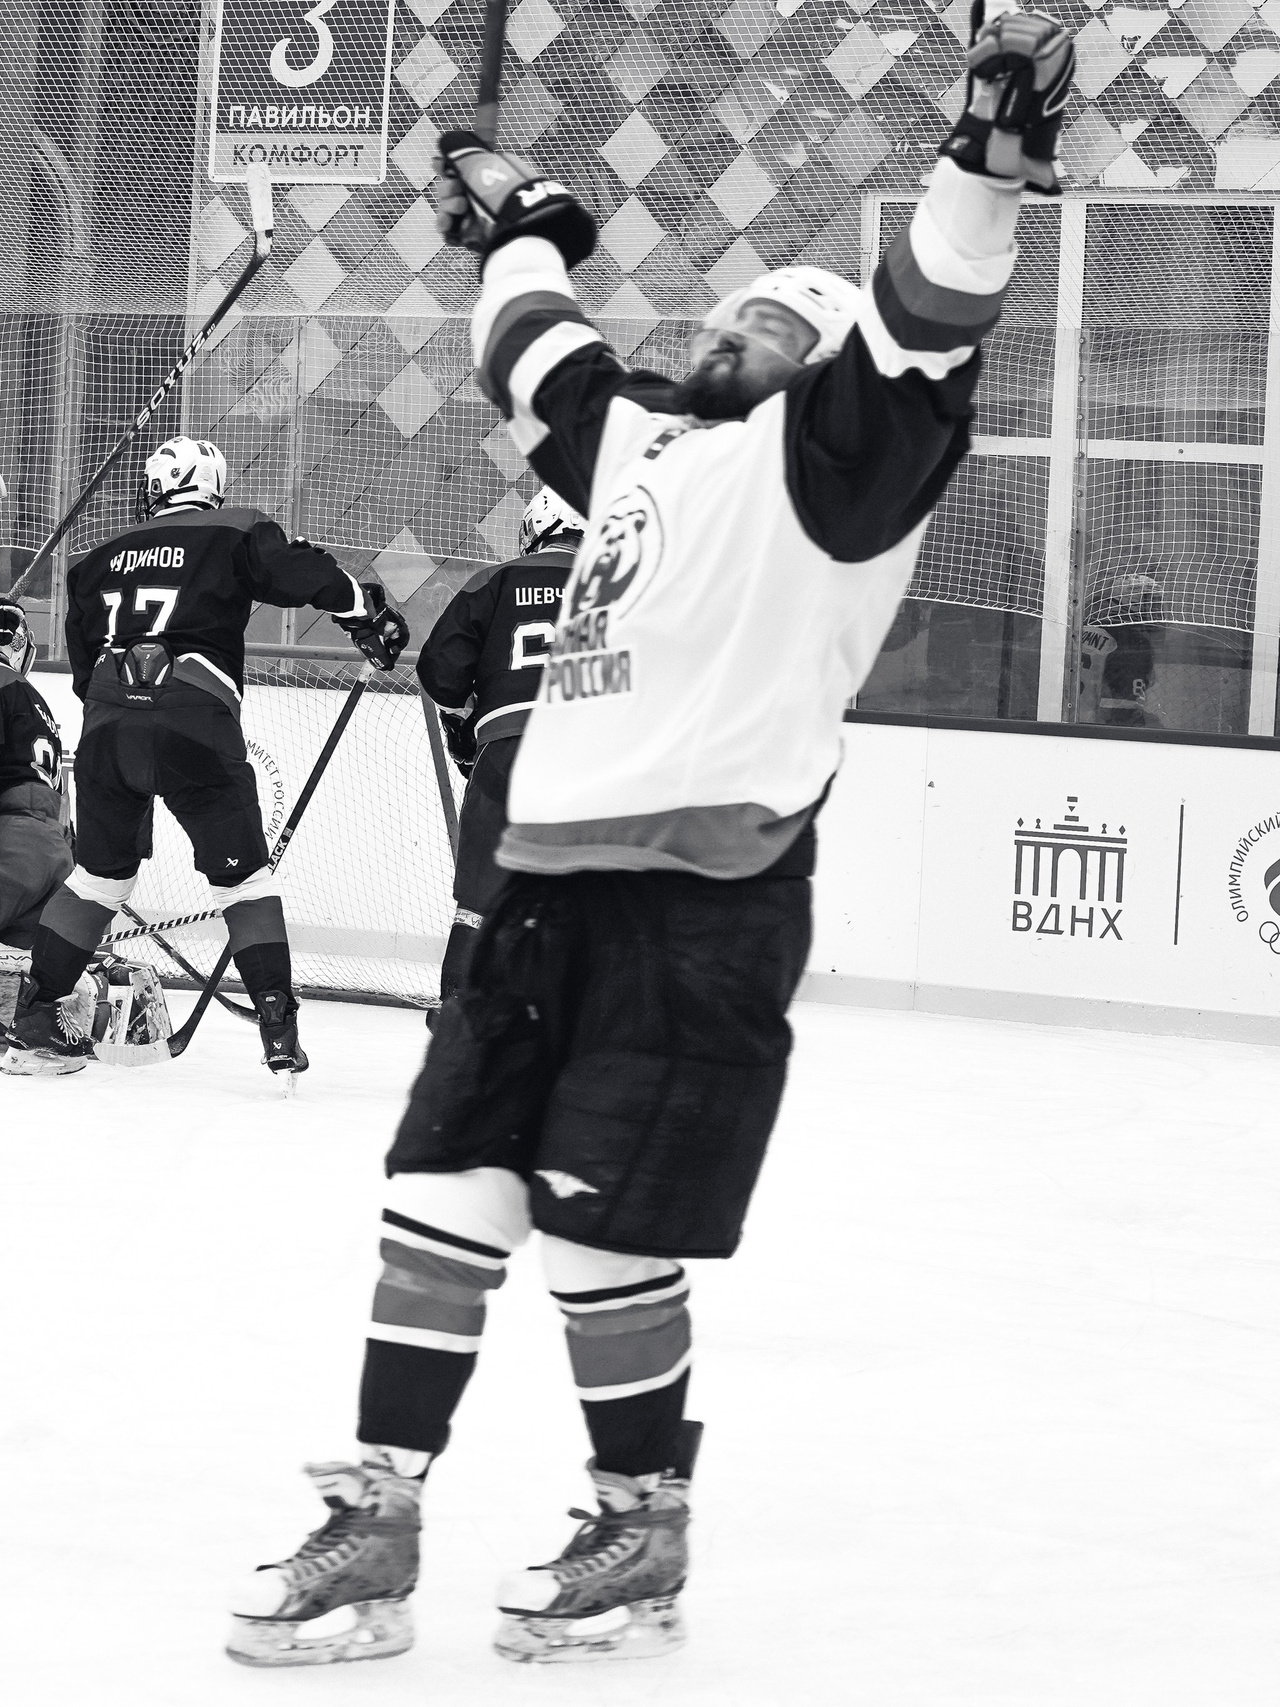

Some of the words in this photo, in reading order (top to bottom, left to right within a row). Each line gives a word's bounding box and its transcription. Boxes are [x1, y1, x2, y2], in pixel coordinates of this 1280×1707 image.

[270, 0, 336, 88] 3
[228, 105, 371, 128] ПАВИЛЬОН
[232, 143, 364, 167] КОМФОРТ
[136, 331, 206, 430] SOYUZ
[100, 585, 181, 644] 17
[515, 587, 566, 607] ШЕВЧ
[246, 739, 280, 776] МИТЕТ
[264, 780, 285, 840] РОССИИ
[267, 838, 288, 876] LACK
[1012, 900, 1124, 941] ВДНХ
